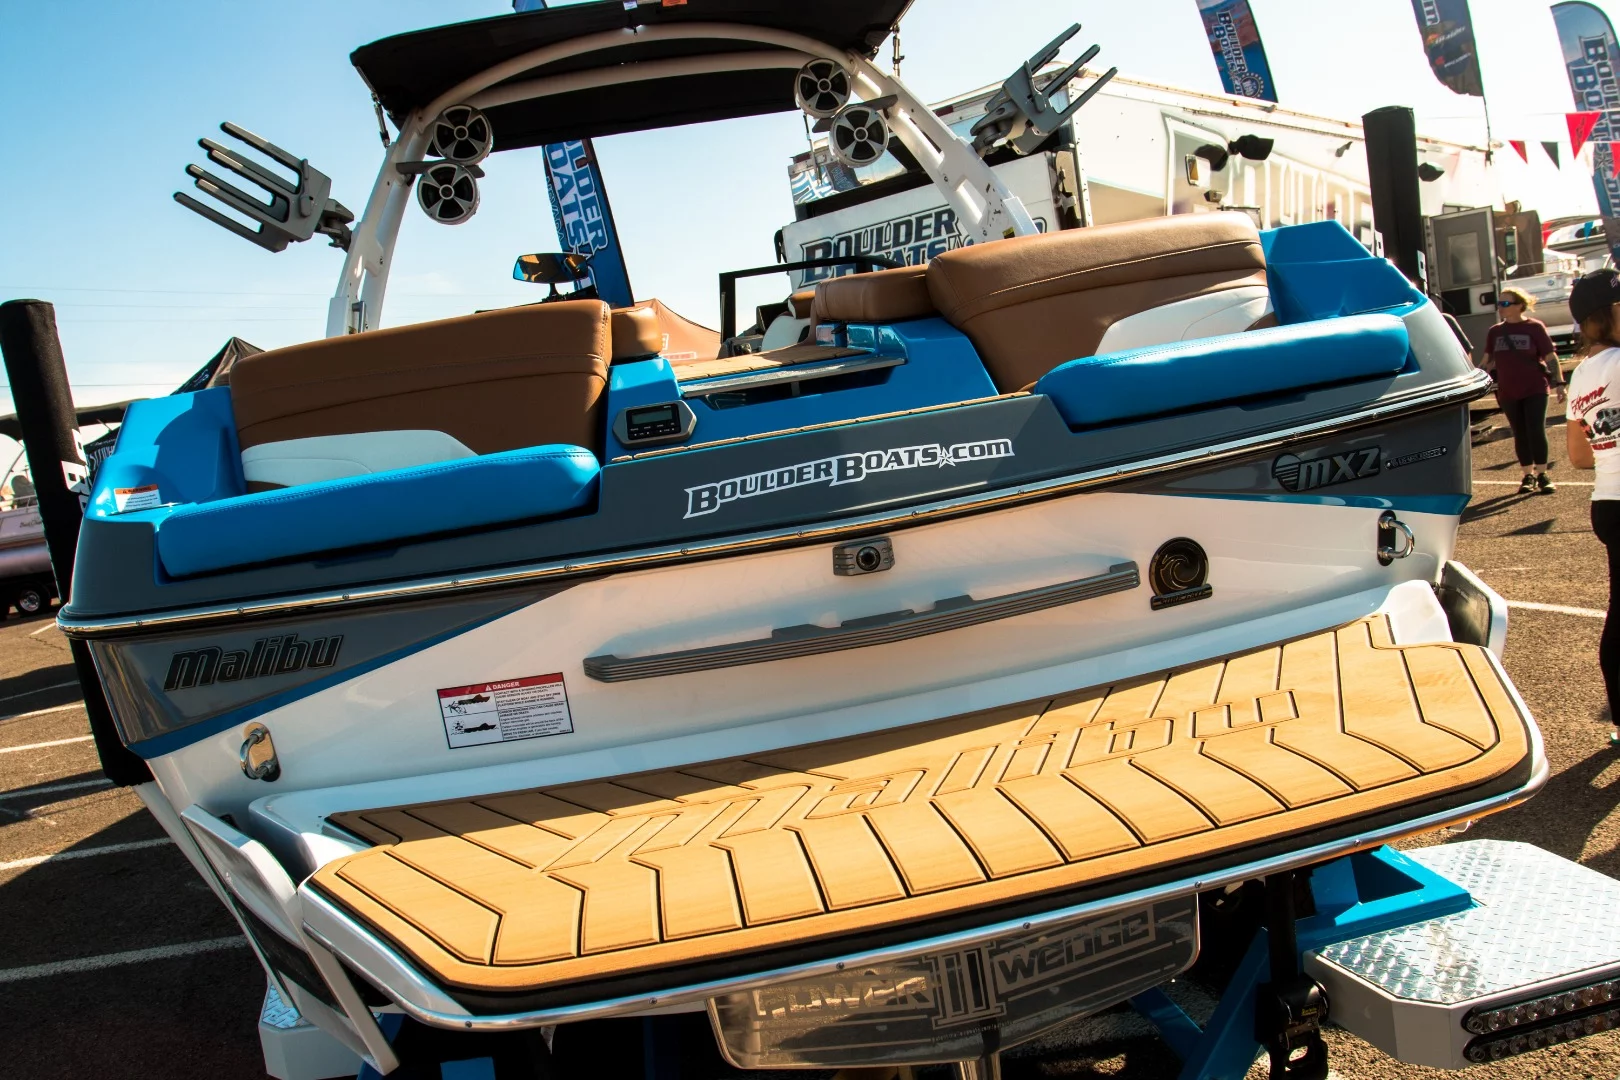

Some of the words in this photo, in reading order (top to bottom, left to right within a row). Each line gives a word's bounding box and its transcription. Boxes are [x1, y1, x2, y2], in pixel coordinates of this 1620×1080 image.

[1216, 11, 1248, 73] BOULDER
[802, 207, 960, 286] BOULDER
[492, 681, 520, 690] DANGER
[999, 910, 1150, 985] WEDGE
